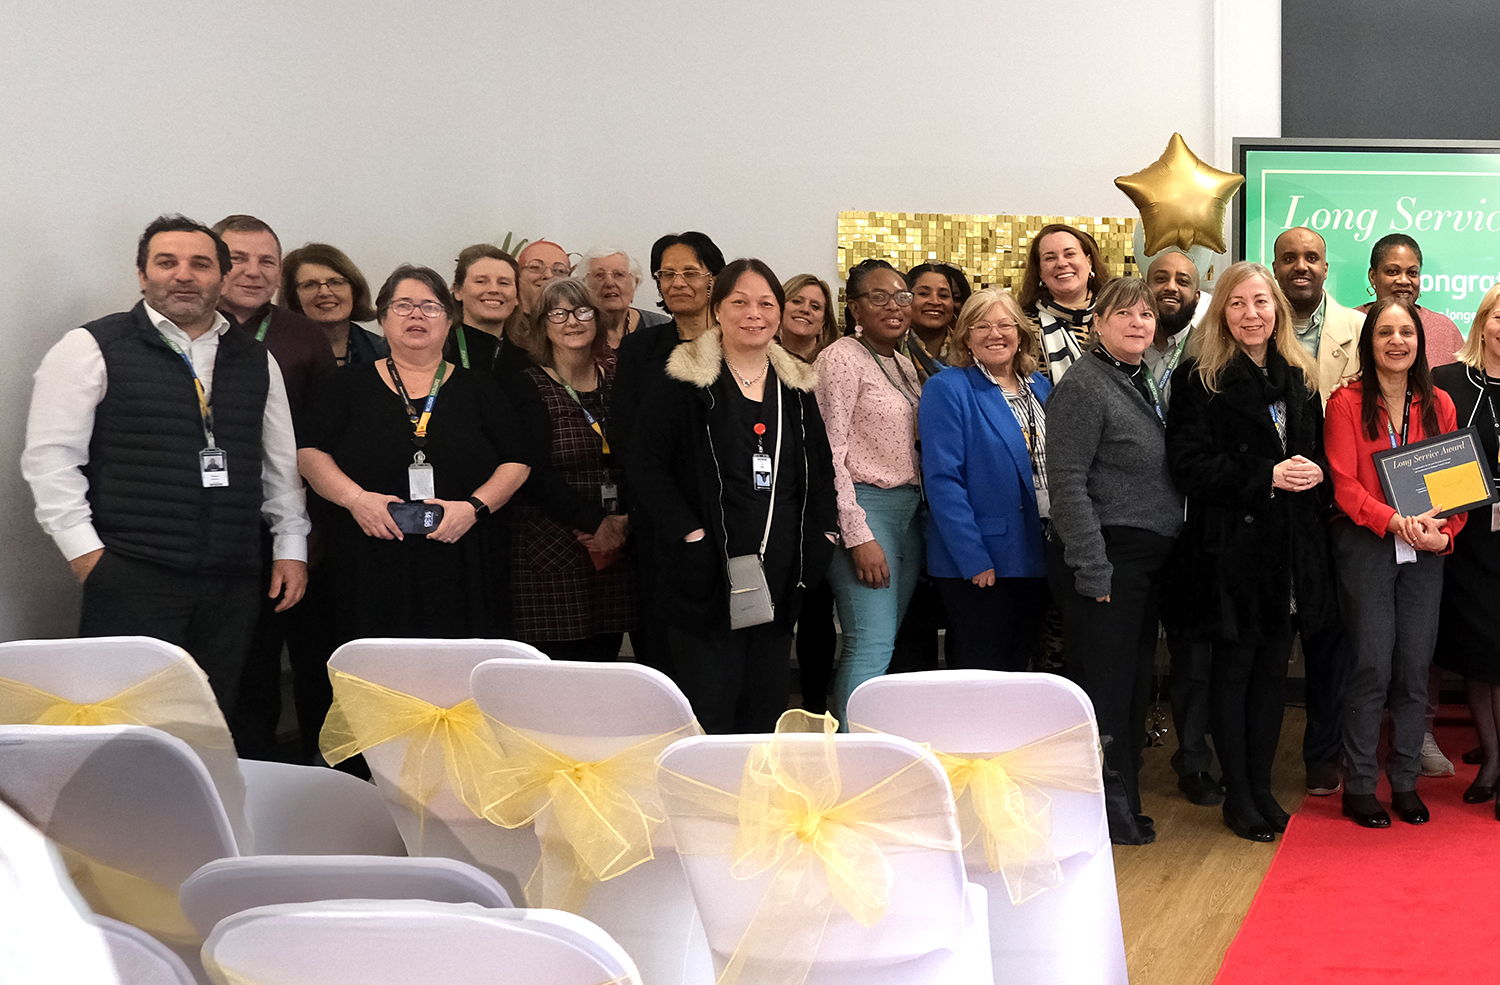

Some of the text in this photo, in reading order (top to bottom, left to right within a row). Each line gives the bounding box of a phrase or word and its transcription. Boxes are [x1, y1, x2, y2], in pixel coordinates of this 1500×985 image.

[1280, 195, 1378, 242] Long
[1393, 458, 1413, 470] Long
[1413, 450, 1440, 463] Service
[1441, 441, 1465, 455] Award
